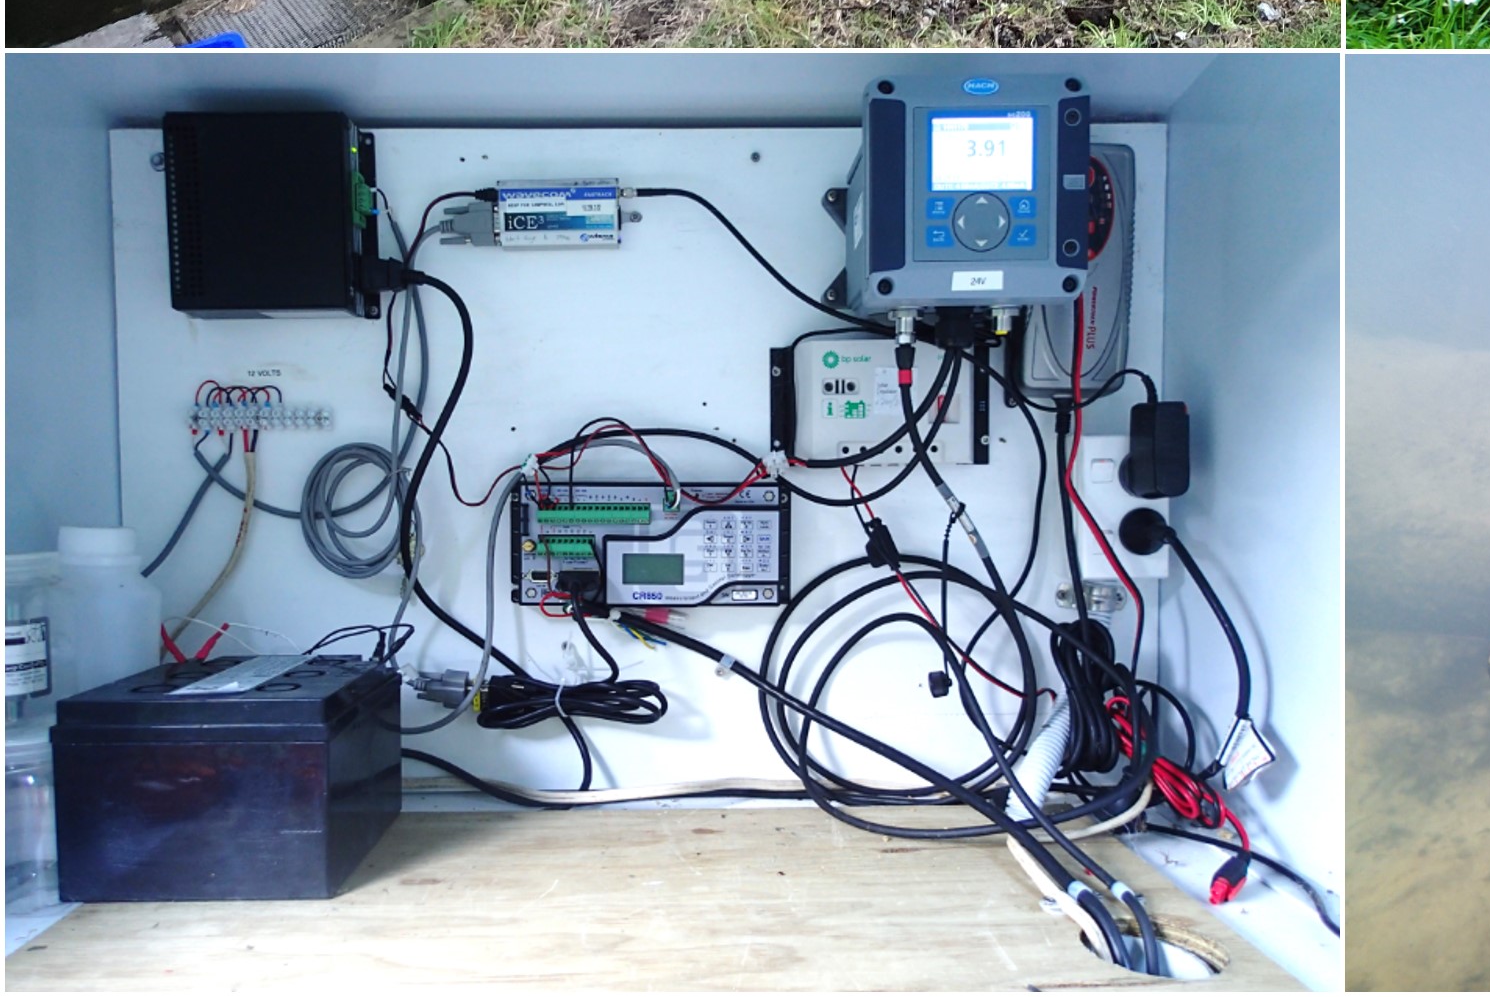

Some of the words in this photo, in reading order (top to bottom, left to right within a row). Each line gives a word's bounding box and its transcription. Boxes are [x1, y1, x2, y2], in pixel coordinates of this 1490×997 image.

[967, 139, 1006, 157] 3.91
[841, 355, 852, 363] bp
[853, 354, 872, 362] solar
[257, 369, 282, 377] VOLTS
